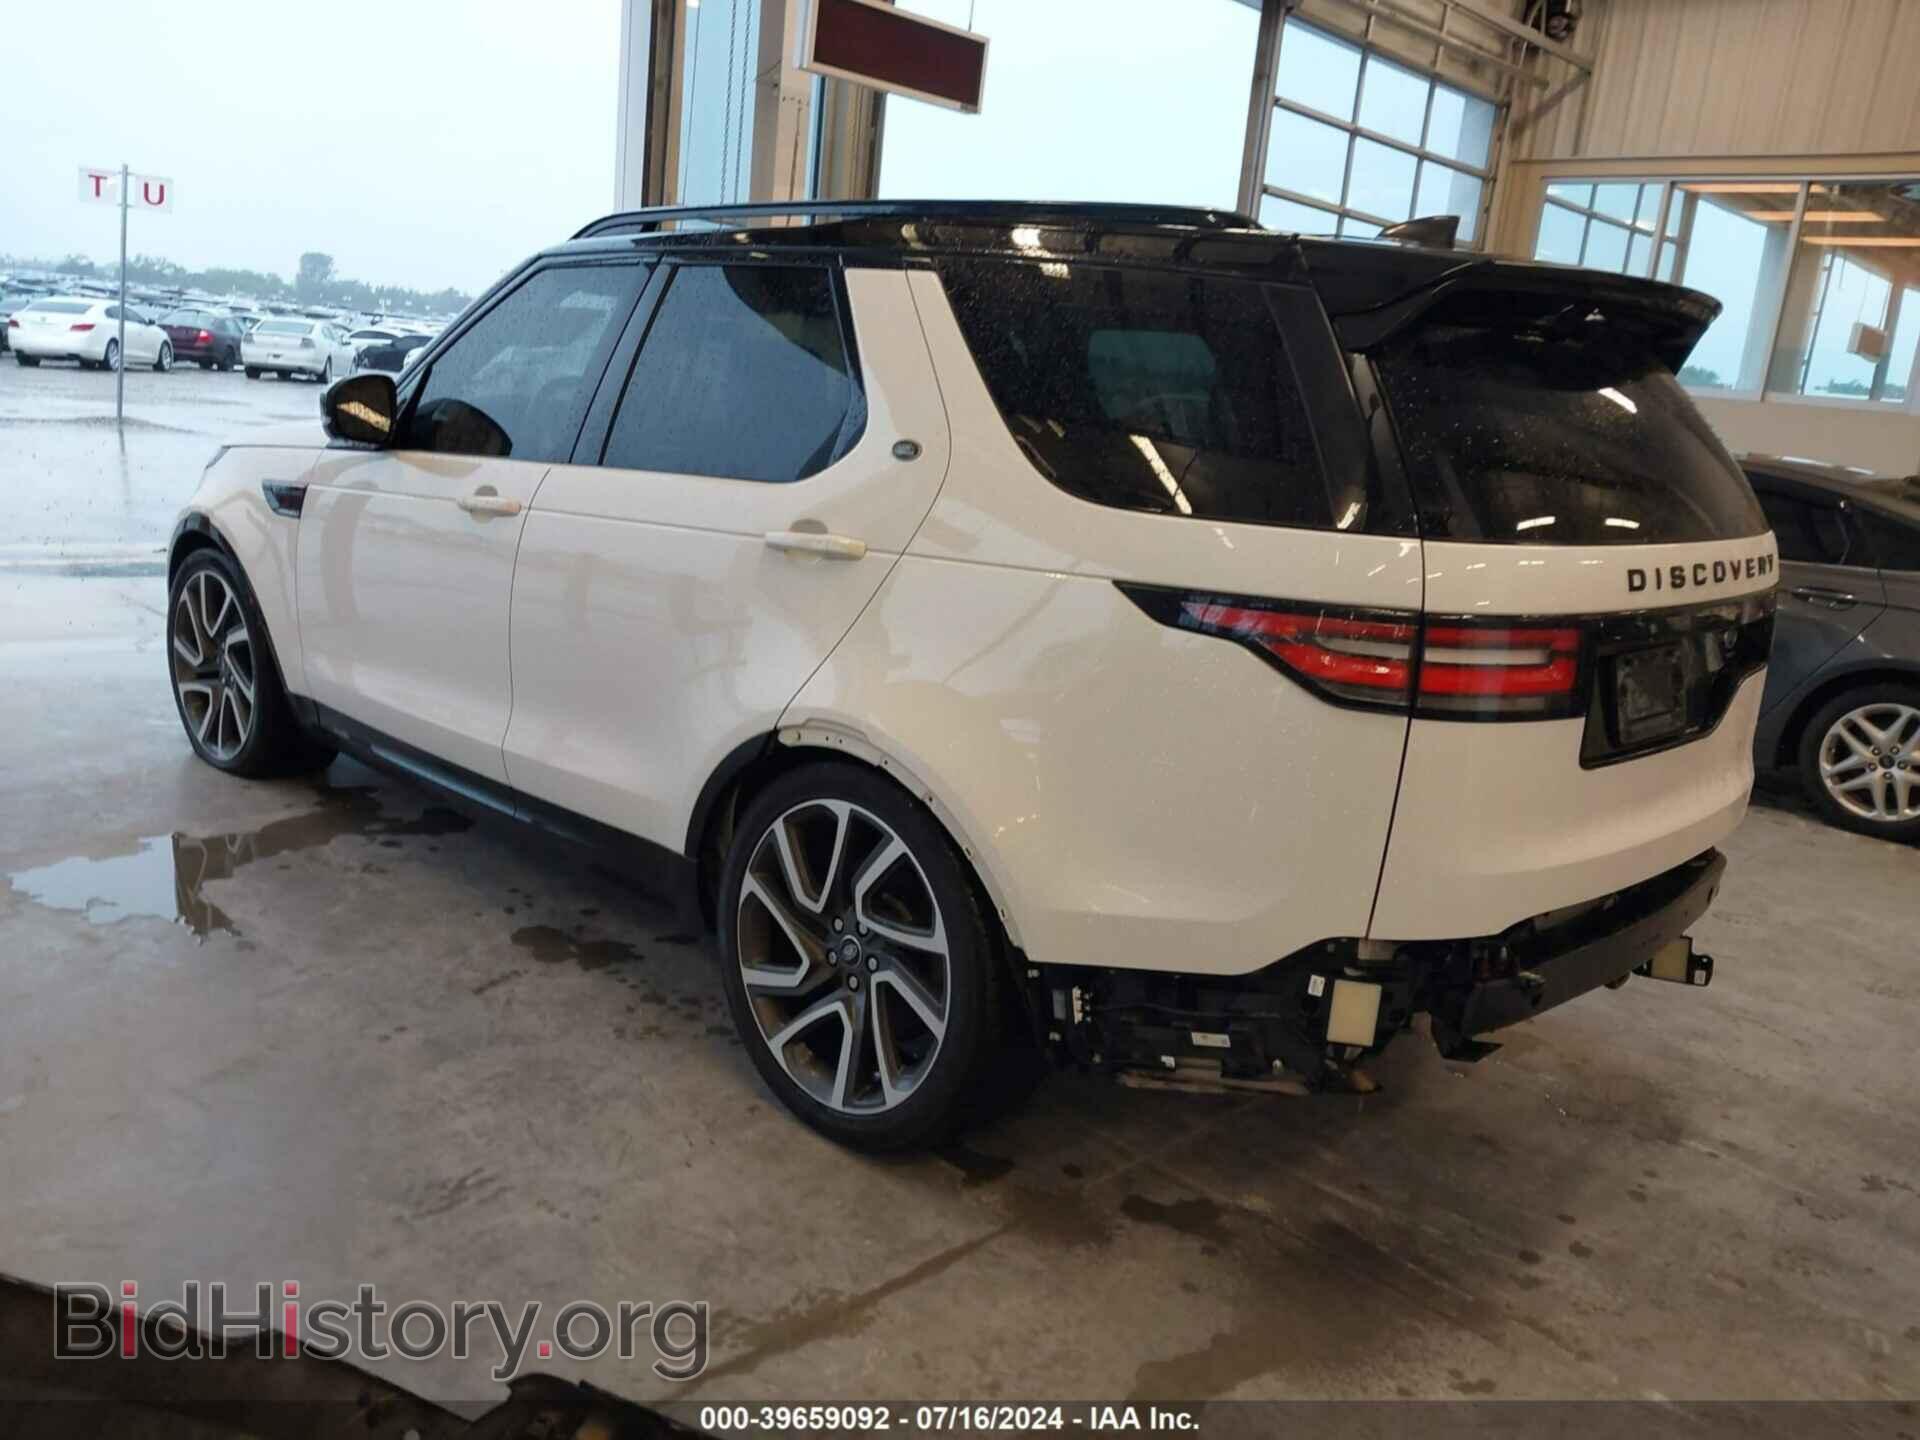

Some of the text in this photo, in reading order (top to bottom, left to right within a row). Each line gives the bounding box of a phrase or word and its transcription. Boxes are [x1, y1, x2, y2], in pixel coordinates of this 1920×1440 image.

[88, 174, 107, 197] T
[143, 181, 165, 206] U
[1627, 553, 1774, 592] DISCOVERY
